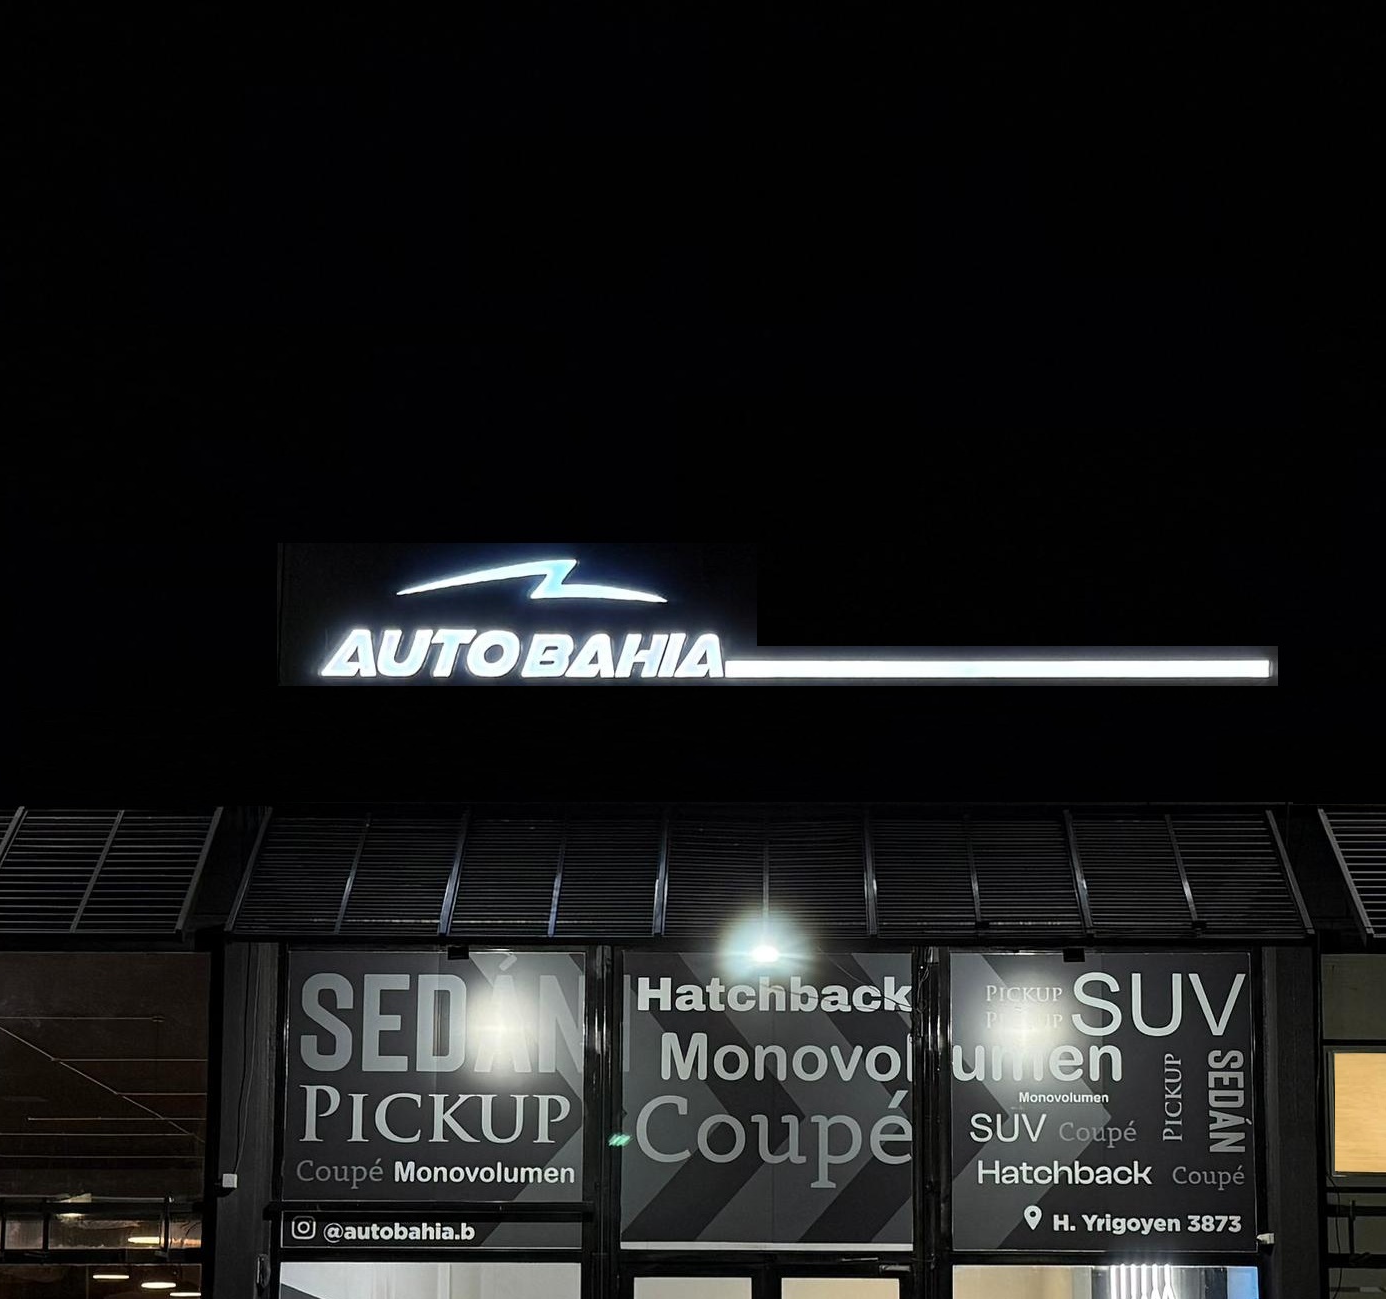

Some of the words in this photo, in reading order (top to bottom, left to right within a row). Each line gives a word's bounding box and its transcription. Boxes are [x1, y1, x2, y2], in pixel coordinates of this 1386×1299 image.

[637, 976, 913, 1012] Hatchback
[1071, 971, 1246, 1037] SUV
[299, 1084, 572, 1144] PICKUP
[1019, 1091, 1109, 1103] Monovolumen
[1162, 1053, 1183, 1142] PICKUP
[1207, 1050, 1252, 1153] SEDÁN
[636, 1090, 913, 1189] Coupé
[969, 1113, 1047, 1143] SUV
[1059, 1120, 1138, 1148] Coupé
[296, 1158, 384, 1189] Coupé
[393, 1161, 576, 1184] Monovolumen
[977, 1160, 1153, 1185] Hatchback
[1172, 1165, 1246, 1190] Coupé
[323, 1222, 476, 1243] @autobahia.b
[1053, 1214, 1076, 1232] H.
[1082, 1214, 1182, 1235] Yrigoyen
[1187, 1214, 1242, 1233] 3873
